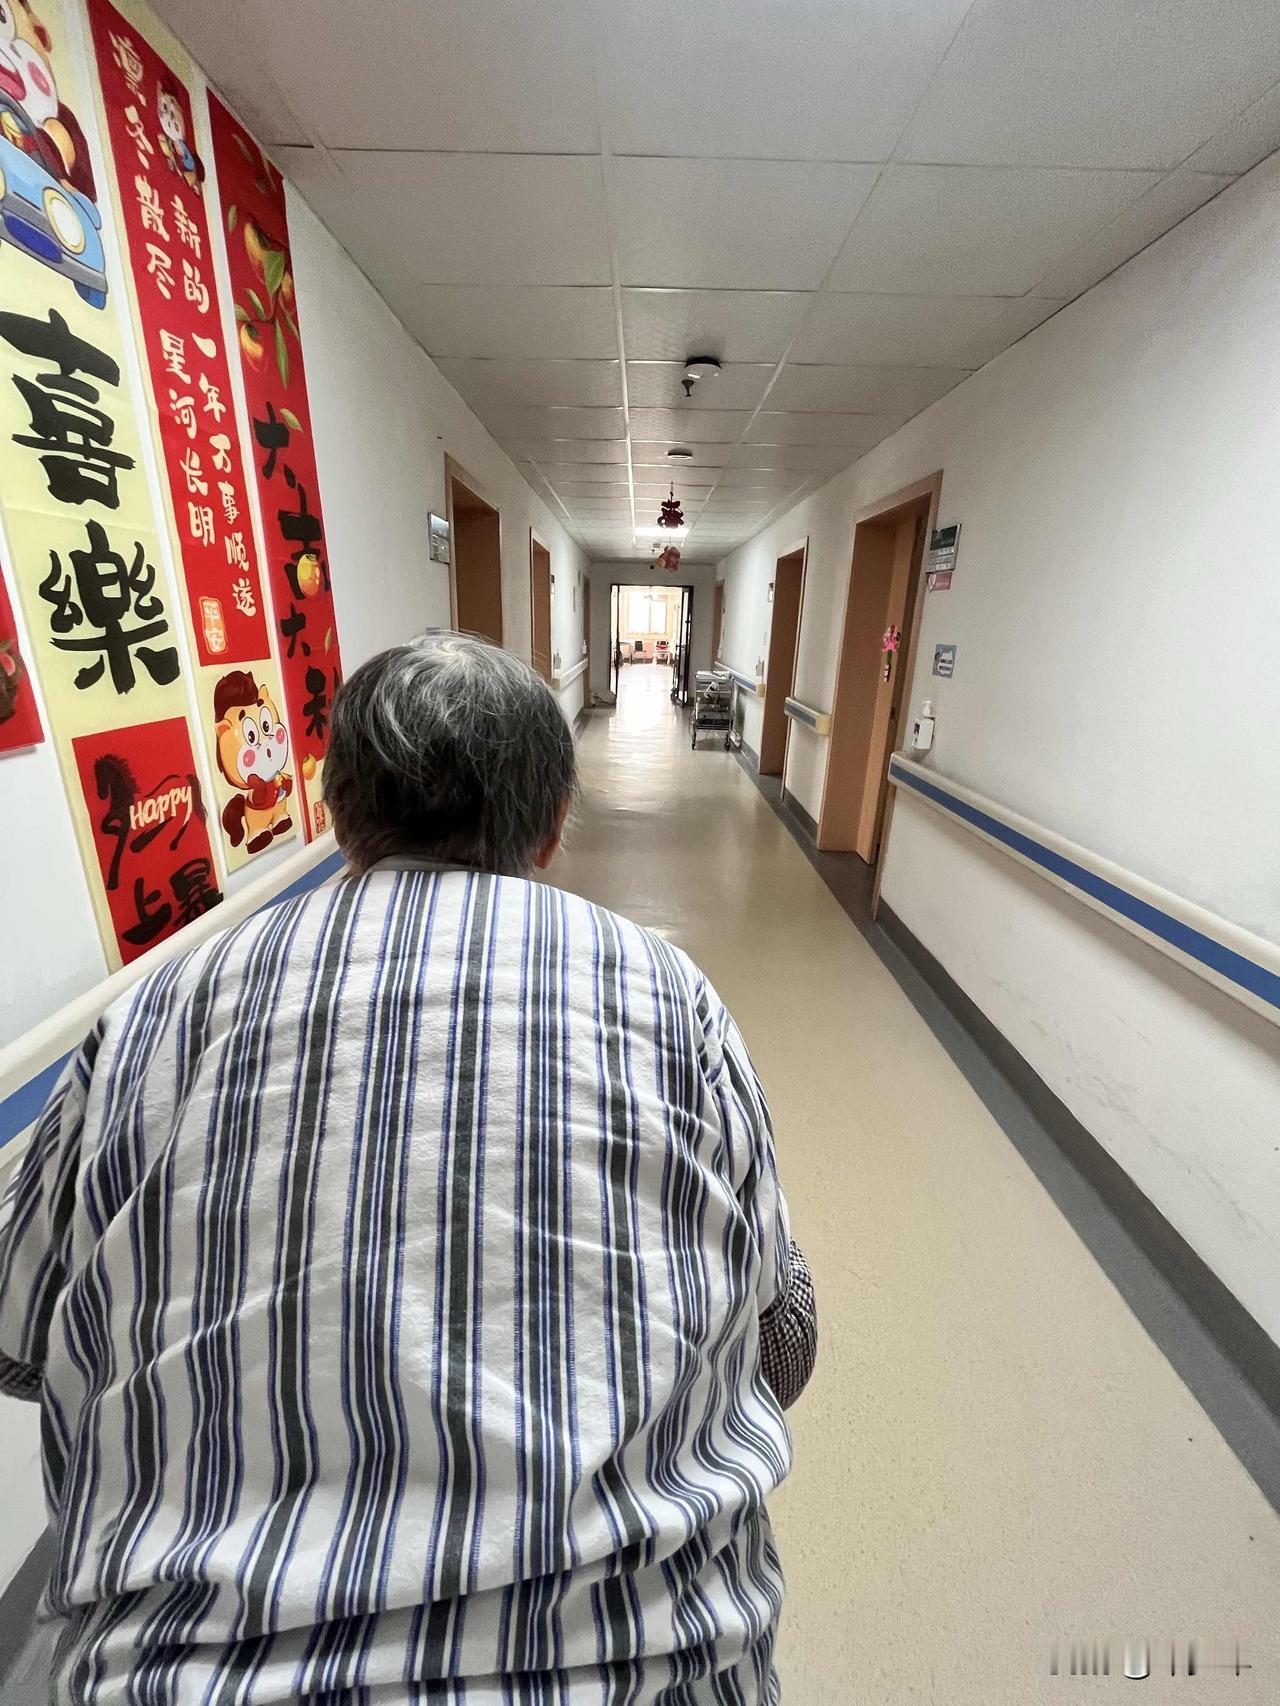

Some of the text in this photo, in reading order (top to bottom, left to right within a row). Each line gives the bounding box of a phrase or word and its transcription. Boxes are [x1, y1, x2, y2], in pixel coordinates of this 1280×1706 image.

[159, 328, 216, 547] 星河长明
[129, 785, 192, 830] Happy
